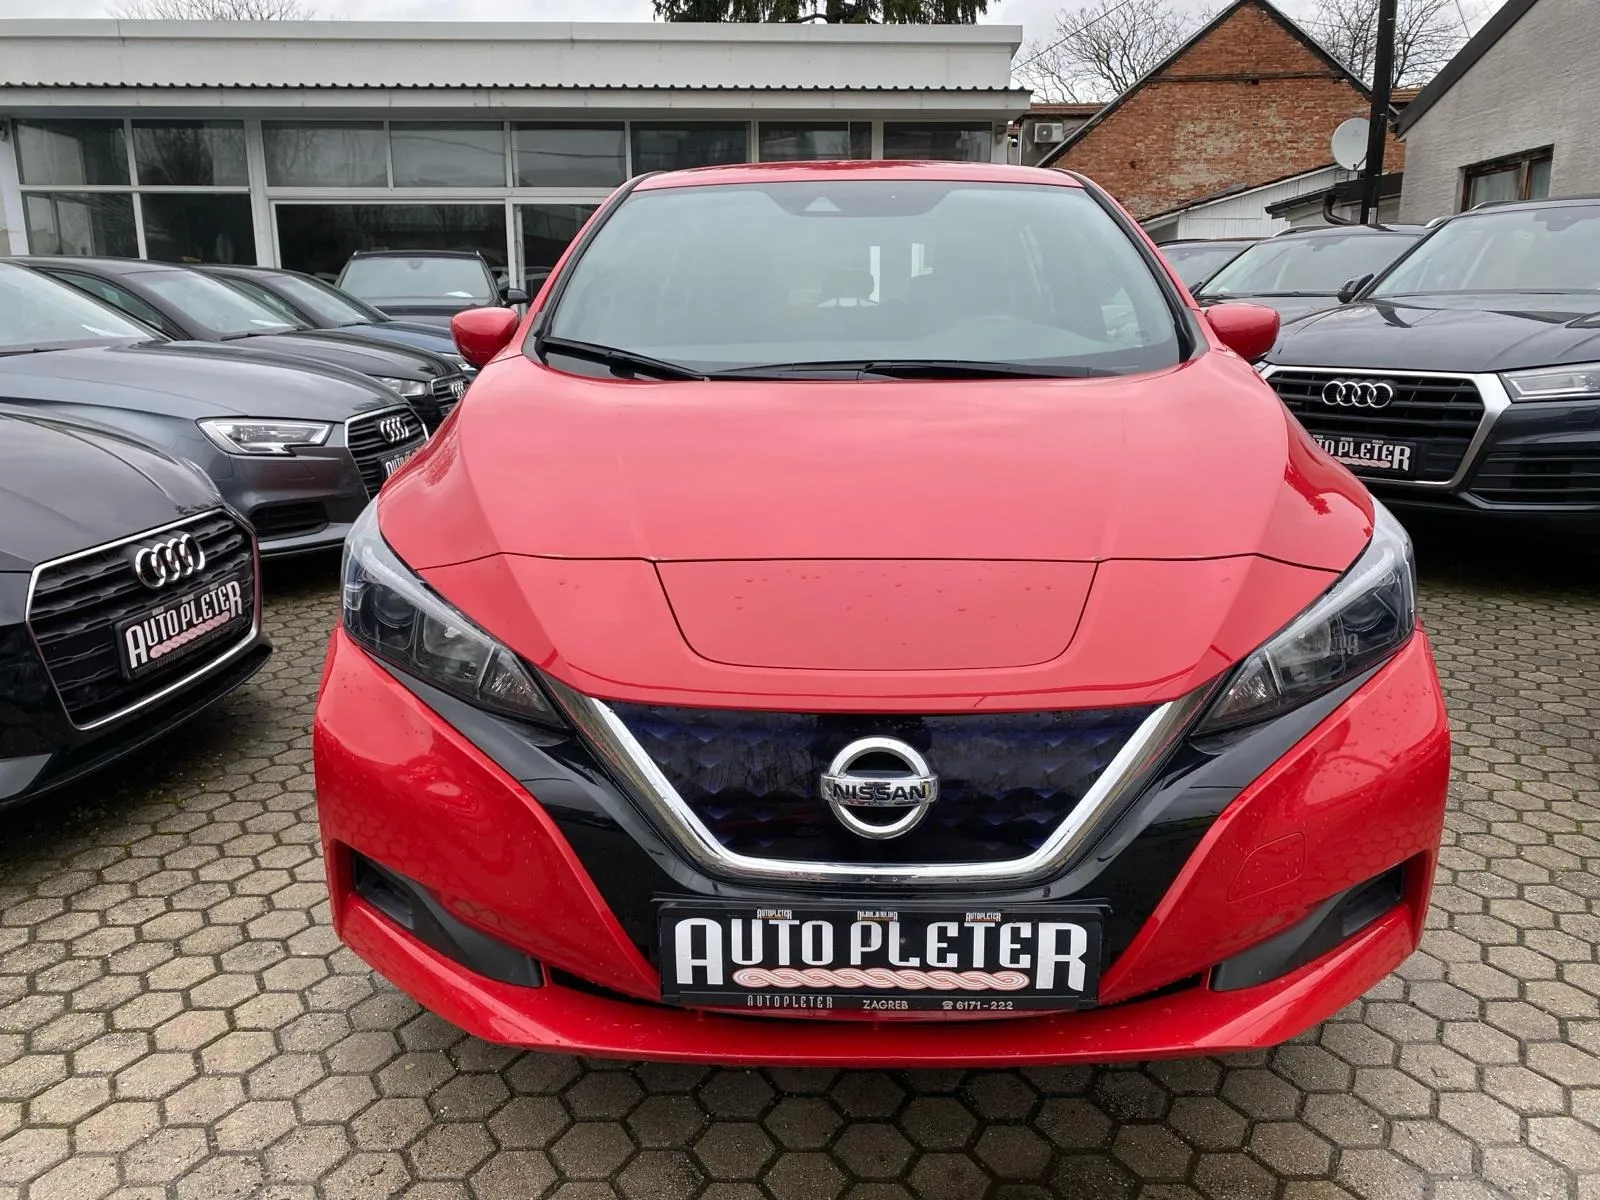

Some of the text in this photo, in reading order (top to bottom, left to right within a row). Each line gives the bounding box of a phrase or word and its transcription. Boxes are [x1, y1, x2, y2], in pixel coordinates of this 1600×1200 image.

[1338, 441, 1411, 472] PLETER
[125, 580, 242, 669] AUTO PLETER
[833, 783, 926, 801] NISSAN
[757, 909, 792, 920] AUTOPLETER
[965, 912, 1002, 922] AUTOPLETER
[674, 917, 1088, 992] AUTO PLETER
[747, 995, 833, 1009] AUTOPLETER
[862, 1000, 909, 1010] ZAGREB
